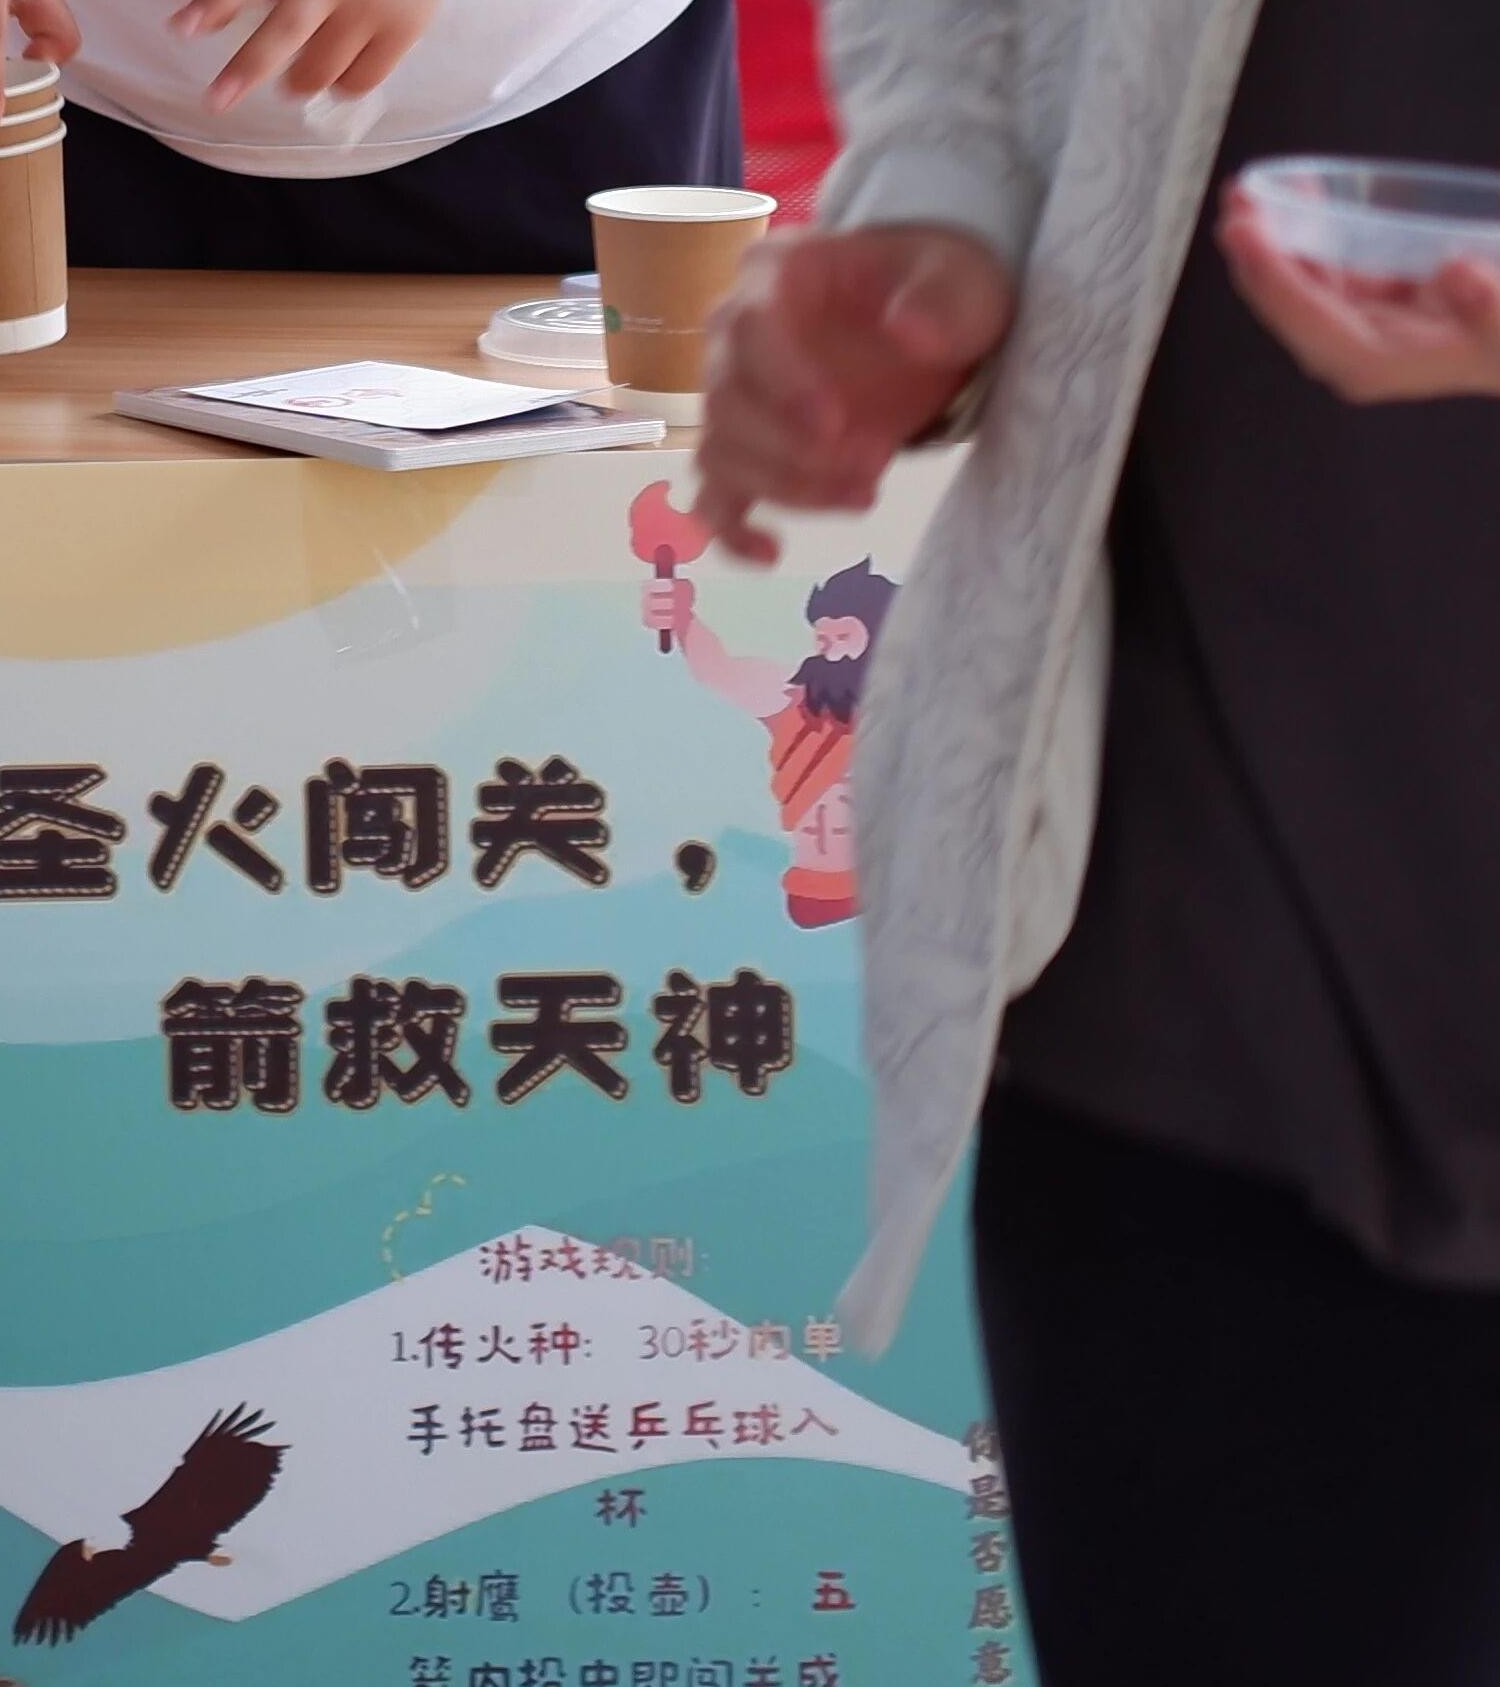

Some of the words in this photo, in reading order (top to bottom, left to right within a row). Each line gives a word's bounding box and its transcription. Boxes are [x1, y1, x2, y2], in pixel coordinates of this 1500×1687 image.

[159, 967, 794, 1113] 箭救天神
[406, 1400, 840, 1455] 手托盘送乒乓球入
[594, 1487, 648, 1529] 杯
